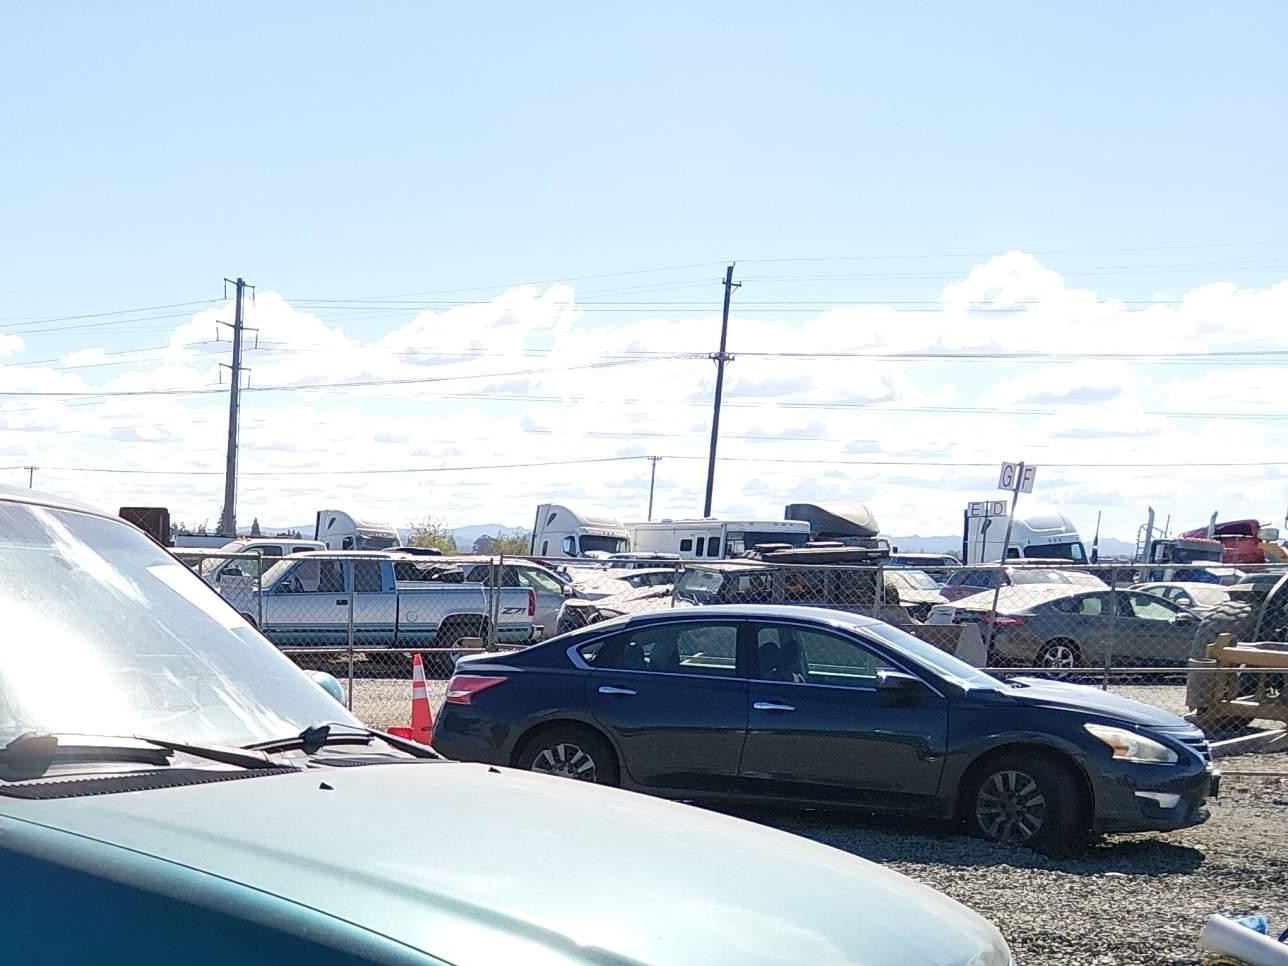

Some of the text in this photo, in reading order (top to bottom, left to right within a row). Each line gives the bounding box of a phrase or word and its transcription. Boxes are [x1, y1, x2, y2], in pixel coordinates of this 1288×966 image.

[1003, 465, 1012, 487] G
[1022, 469, 1032, 489] F
[972, 503, 980, 515] E
[994, 503, 1003, 514] D
